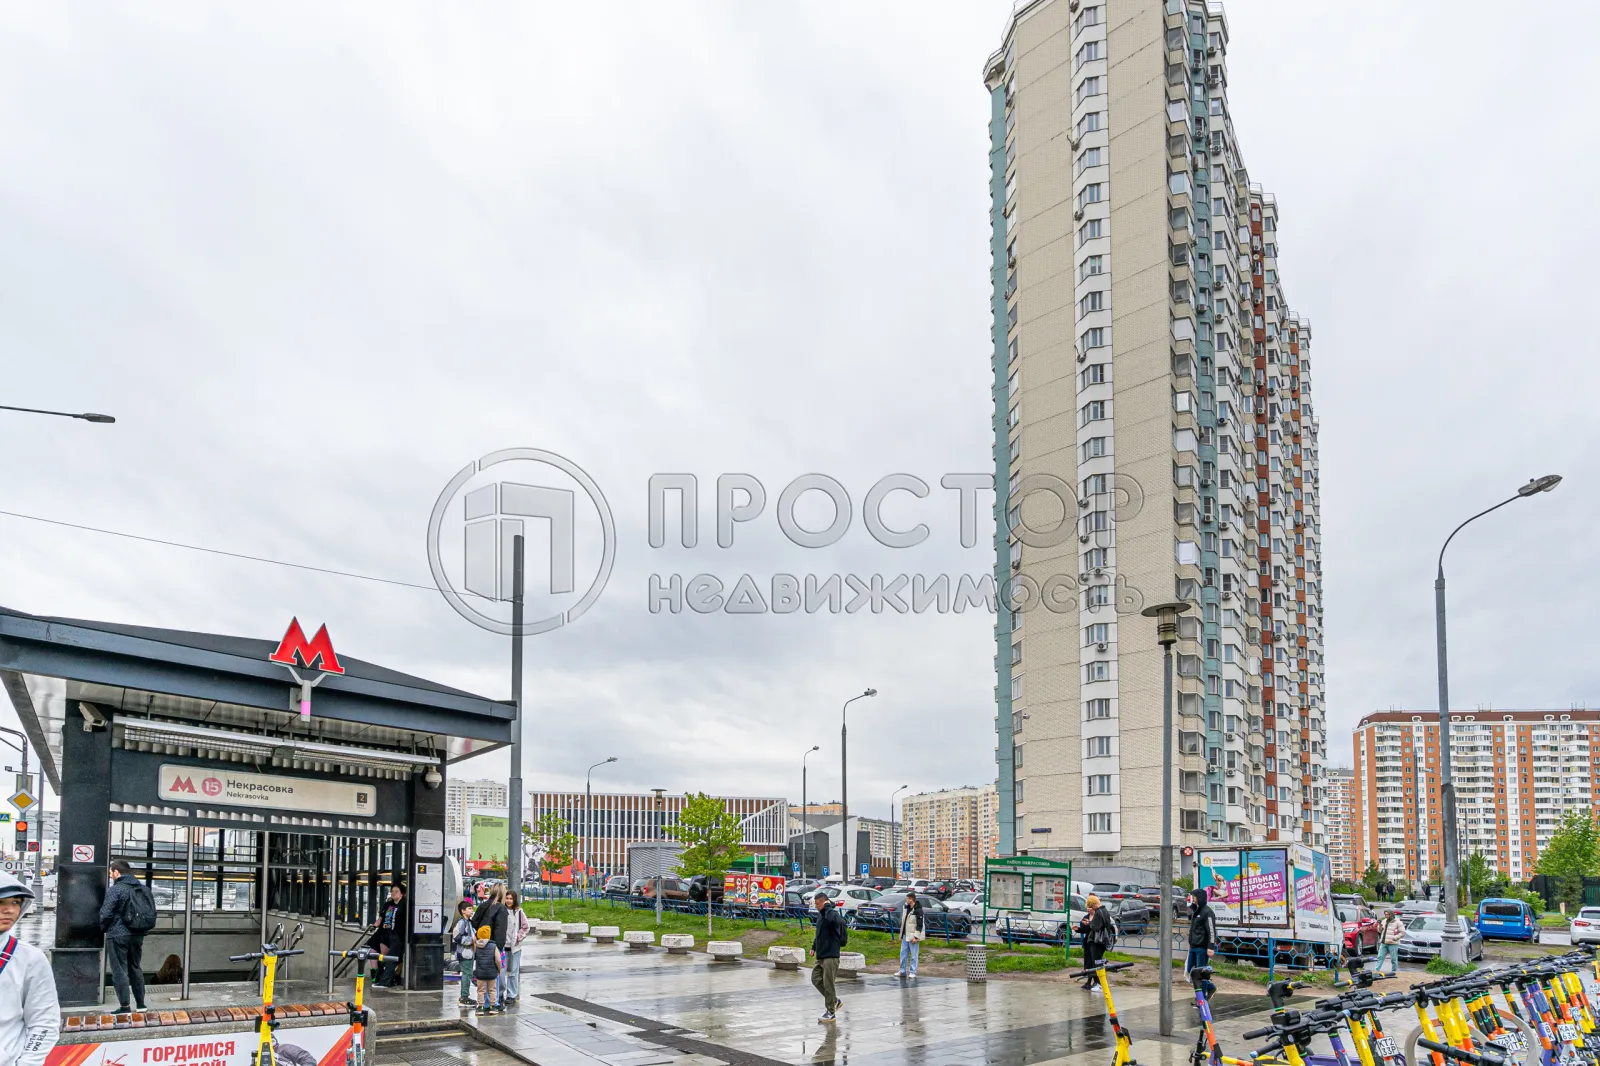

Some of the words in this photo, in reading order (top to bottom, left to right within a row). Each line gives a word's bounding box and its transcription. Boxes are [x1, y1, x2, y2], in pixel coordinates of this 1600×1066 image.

[204, 779, 219, 792] 15
[227, 779, 293, 794] Некрасовка
[226, 791, 269, 801] Nekrasovka
[1229, 873, 1279, 889] МЕБЕЛЬНАЯ
[143, 1041, 235, 1063] ГОРДИМСЯ
